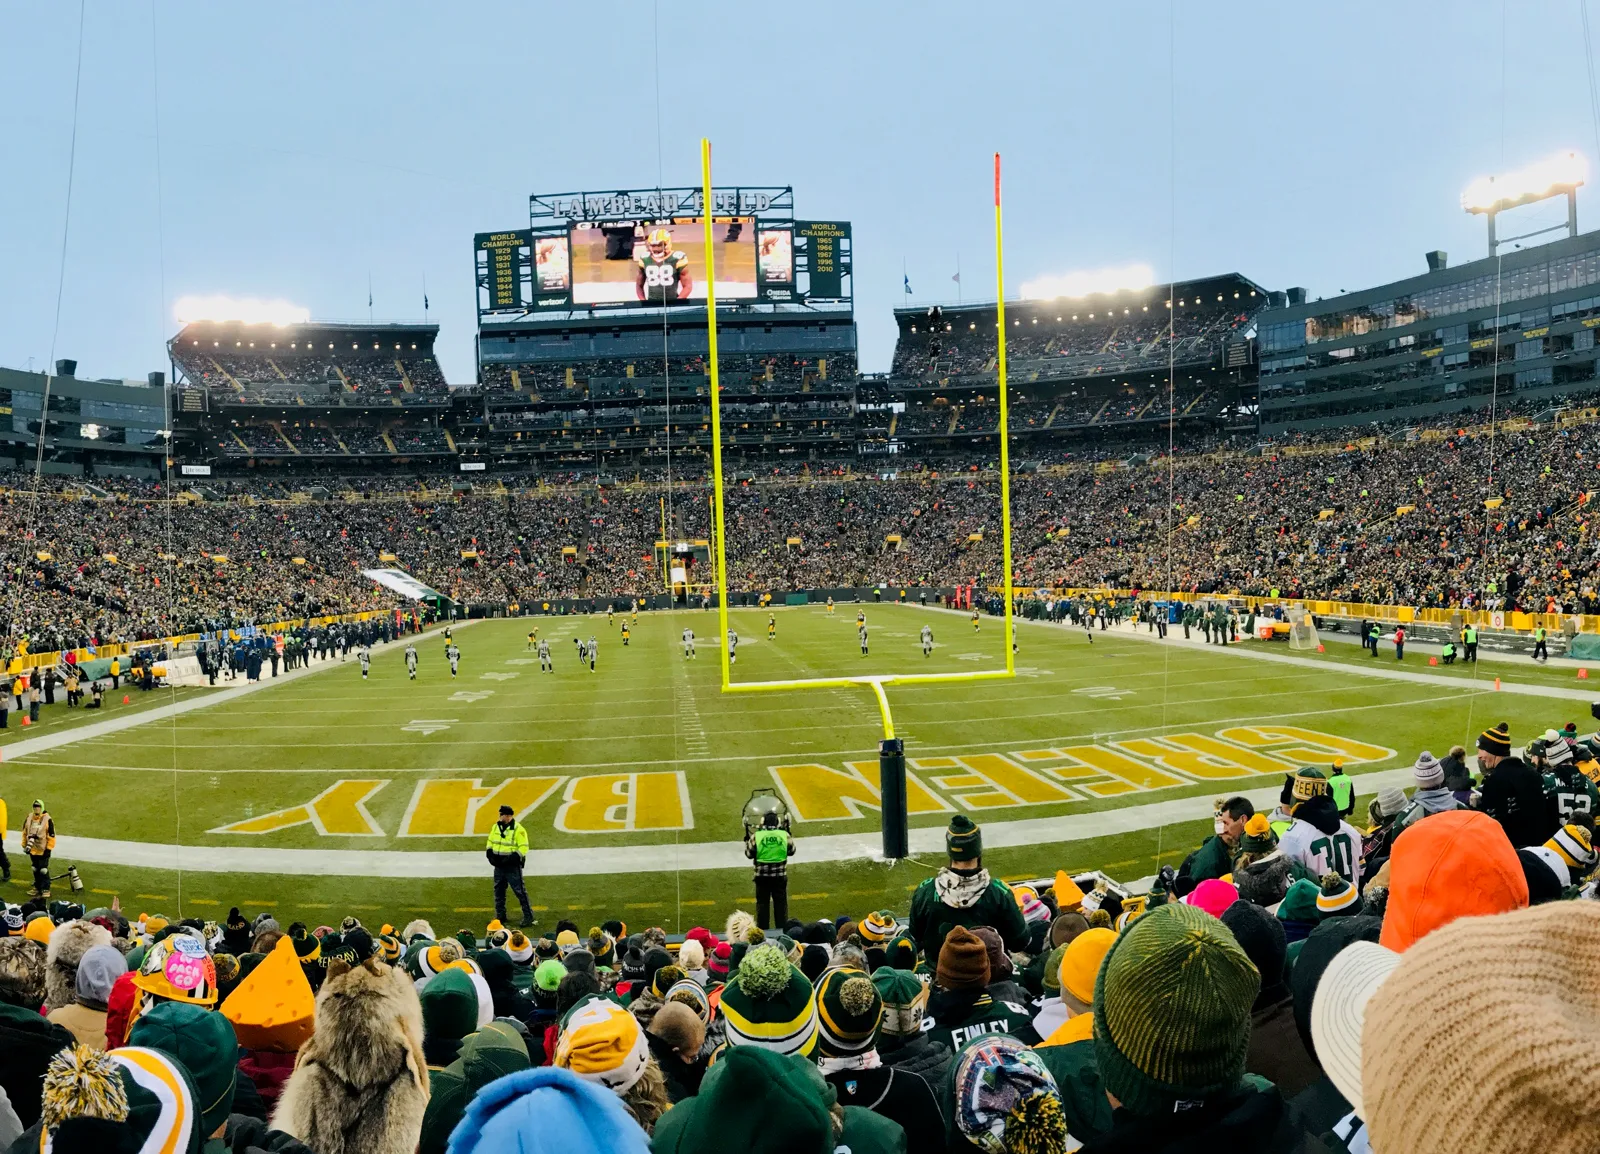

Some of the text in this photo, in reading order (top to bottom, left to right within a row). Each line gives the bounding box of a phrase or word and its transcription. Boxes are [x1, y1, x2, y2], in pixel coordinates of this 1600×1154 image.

[553, 193, 770, 218] LAMBEAU FIELD
[490, 233, 516, 241] WORLD
[801, 229, 845, 237] CHAMPIONS
[482, 239, 524, 248] CHAMPIONS
[645, 264, 674, 286] 88
[538, 297, 566, 306] verizon
[204, 725, 1398, 838] GREEN BAY
[1309, 833, 1354, 882] 30
[168, 963, 200, 978] PACK
[174, 974, 193, 986] GO
